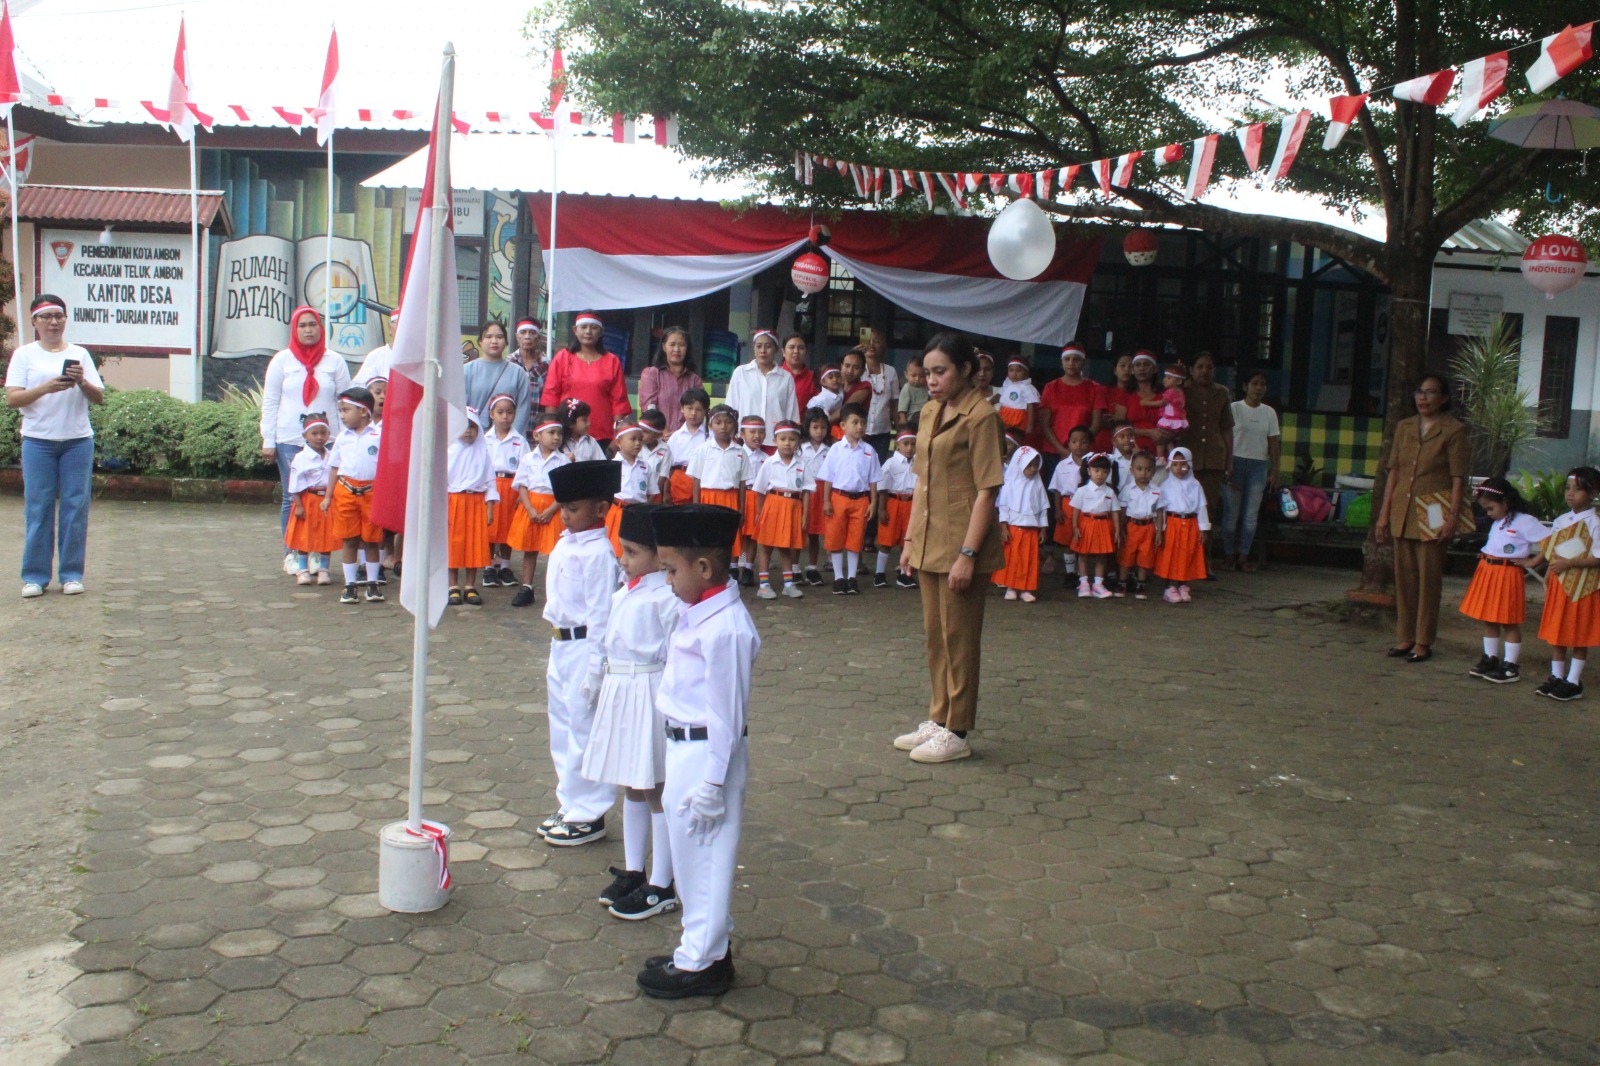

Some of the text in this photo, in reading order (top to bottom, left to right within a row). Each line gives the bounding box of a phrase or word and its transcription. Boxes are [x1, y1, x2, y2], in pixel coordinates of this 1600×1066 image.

[81, 245, 181, 261] PEMERINTAH KOTA AMBON
[1531, 244, 1579, 258] I LOVE
[73, 263, 184, 280] KECAMATAN TELUK AMBON
[231, 255, 289, 286] RUMAH
[1528, 265, 1576, 274] INDONESIA
[87, 283, 173, 305] KANTOR DESA
[225, 285, 292, 326] DATAKU
[73, 307, 109, 324] HUNUTH
[116, 308, 148, 325] DURIAN
[151, 310, 179, 326] PATAH
